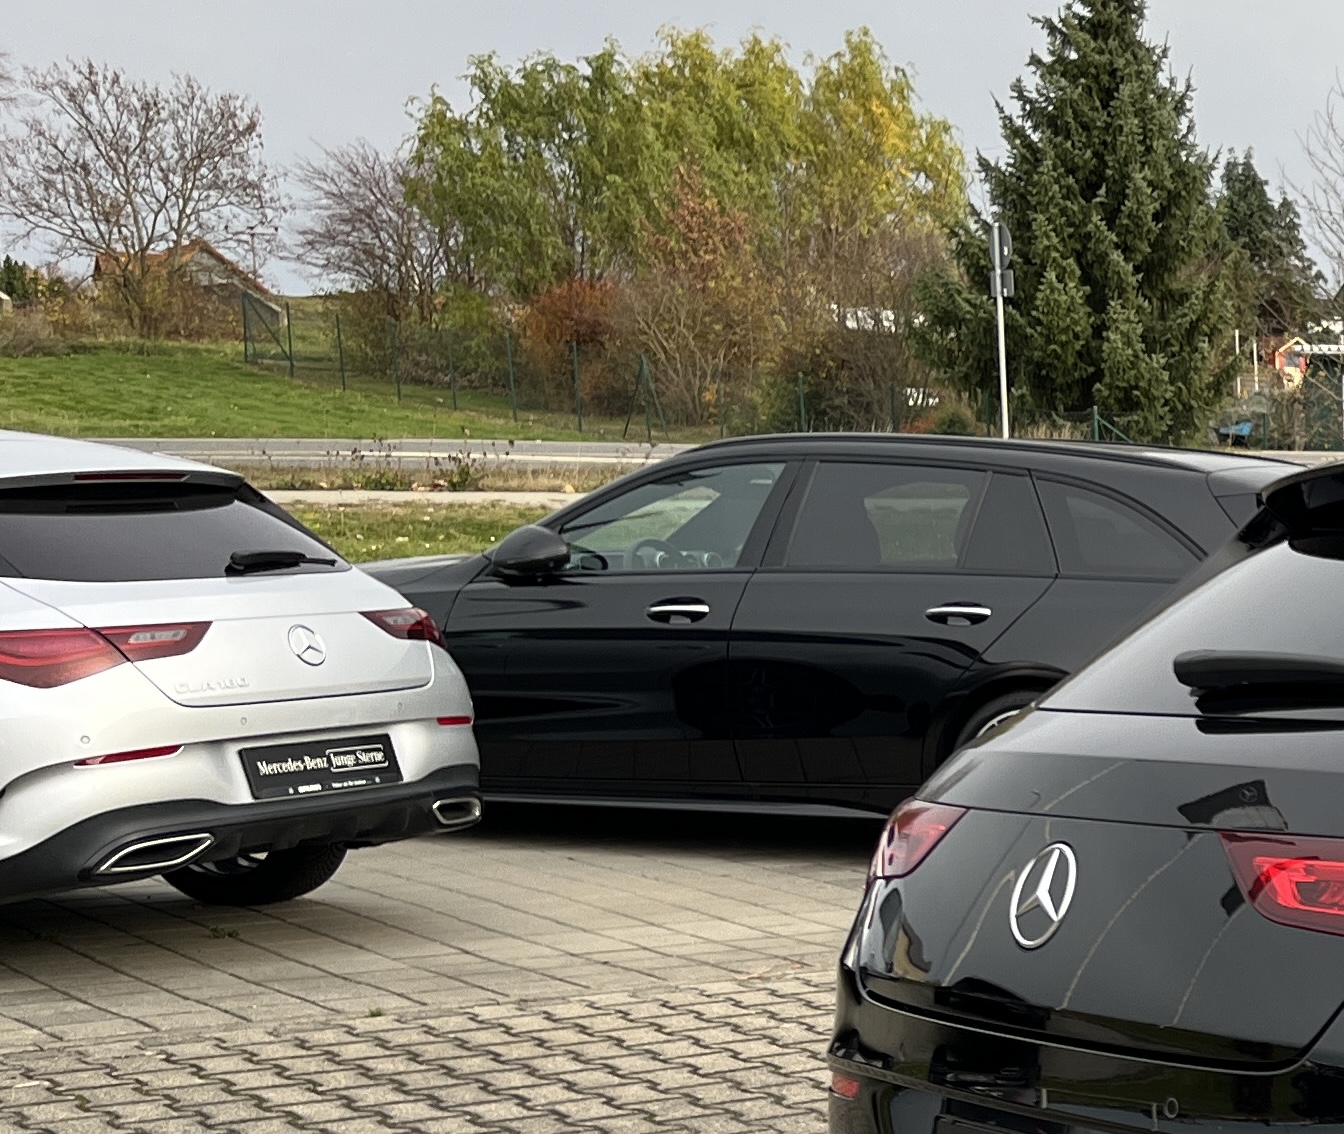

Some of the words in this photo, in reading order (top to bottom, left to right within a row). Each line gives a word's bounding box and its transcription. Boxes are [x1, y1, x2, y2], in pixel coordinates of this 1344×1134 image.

[257, 755, 329, 775] Mercedes-Benz
[330, 753, 356, 768] Junge
[356, 750, 385, 764] Sterne
